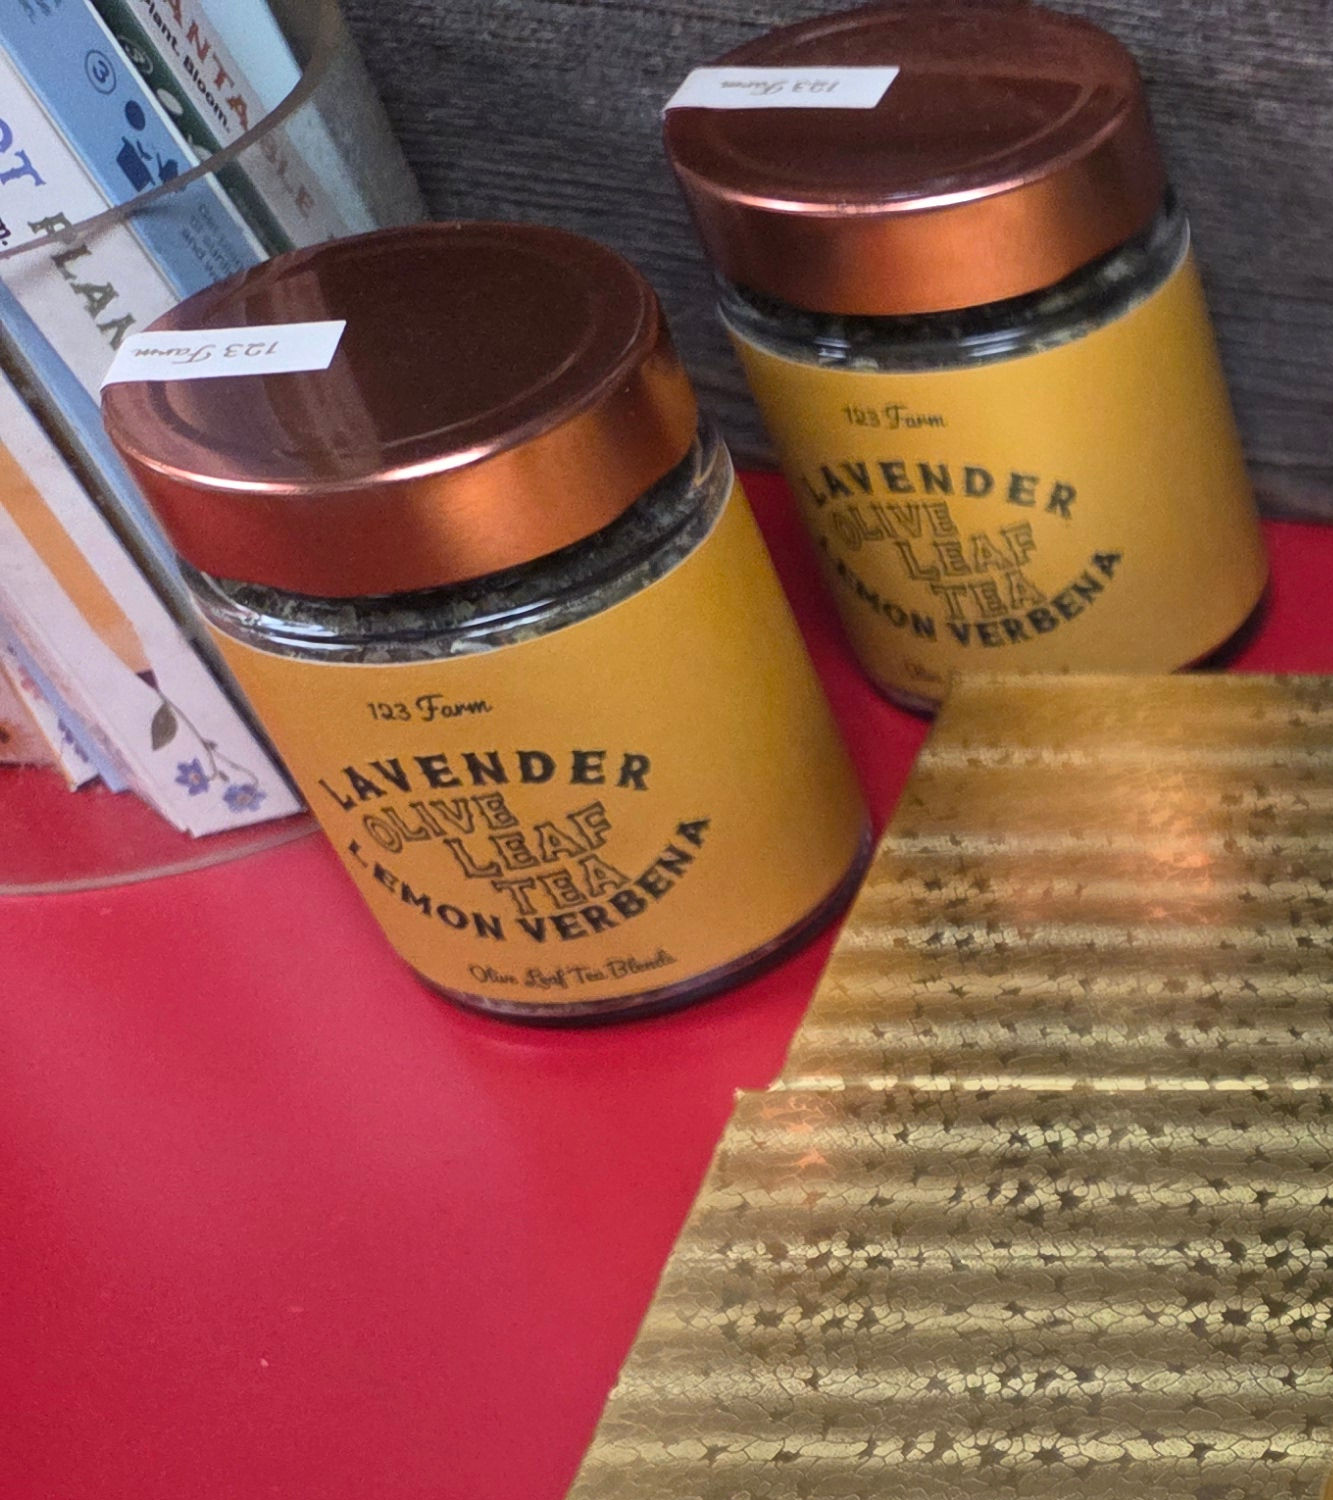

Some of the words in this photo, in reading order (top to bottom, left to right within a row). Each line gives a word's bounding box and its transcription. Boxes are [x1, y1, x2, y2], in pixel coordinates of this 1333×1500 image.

[182, 54, 231, 135] Bloom.
[791, 79, 842, 94] 123
[132, 343, 217, 365] Farm
[222, 340, 279, 360] 123
[841, 401, 881, 428] 123
[884, 402, 946, 431] Farm
[801, 456, 1078, 520] LAVENDER
[832, 500, 960, 552] OLIVE
[895, 519, 1037, 582] LEAF
[929, 568, 1051, 620] TEA
[946, 549, 1125, 648] VERBENA
[367, 702, 412, 722] 123
[415, 693, 494, 723] Farm
[318, 749, 651, 812] LAVENDER
[362, 790, 520, 854] OLIVE
[443, 801, 613, 880] LEAF
[348, 838, 506, 941] LEMON
[514, 817, 711, 944] VERBENA
[491, 853, 633, 917] TEA
[468, 964, 519, 985] Olive
[566, 966, 609, 985] Tea
